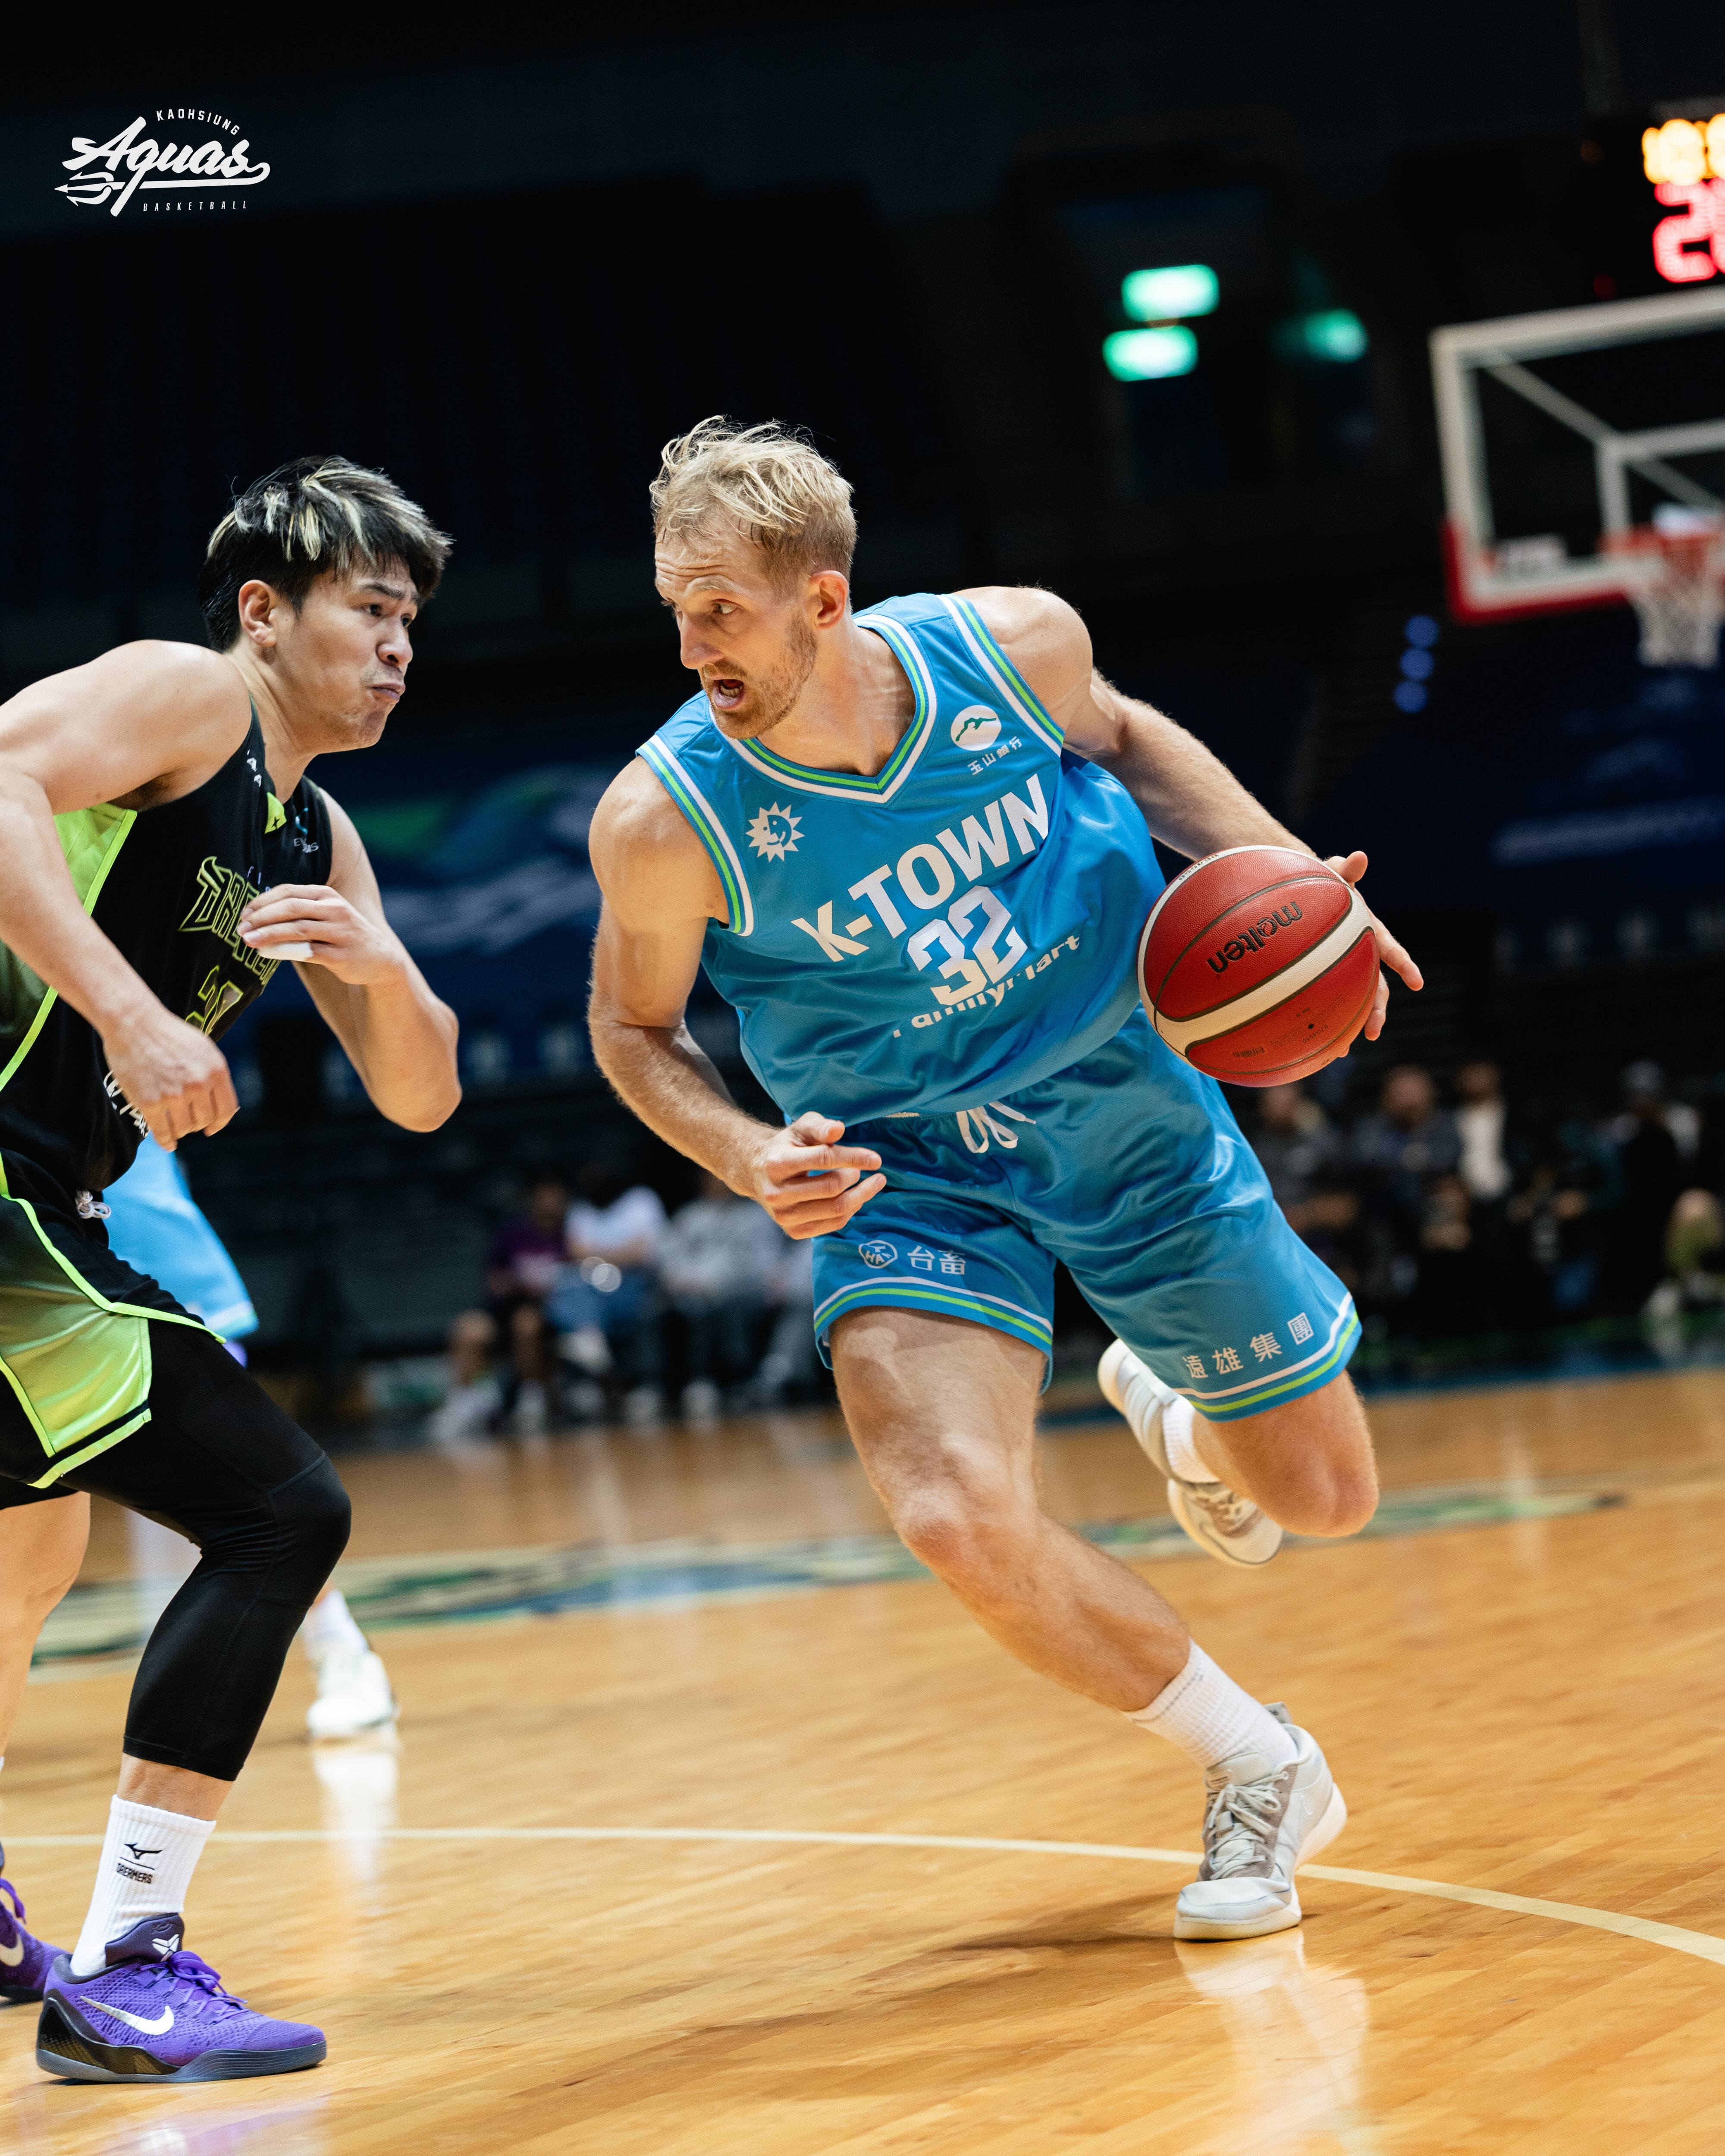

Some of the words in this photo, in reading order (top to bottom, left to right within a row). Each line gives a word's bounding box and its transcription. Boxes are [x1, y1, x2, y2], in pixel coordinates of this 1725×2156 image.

[967, 736, 1022, 775] 玉山銀行
[791, 773, 1049, 962] K-TOWN
[907, 885, 1028, 1006] 32
[1207, 901, 1303, 973] molten
[907, 1245, 966, 1275] 台畜
[1182, 1312, 1314, 1379] 遠雄集團
